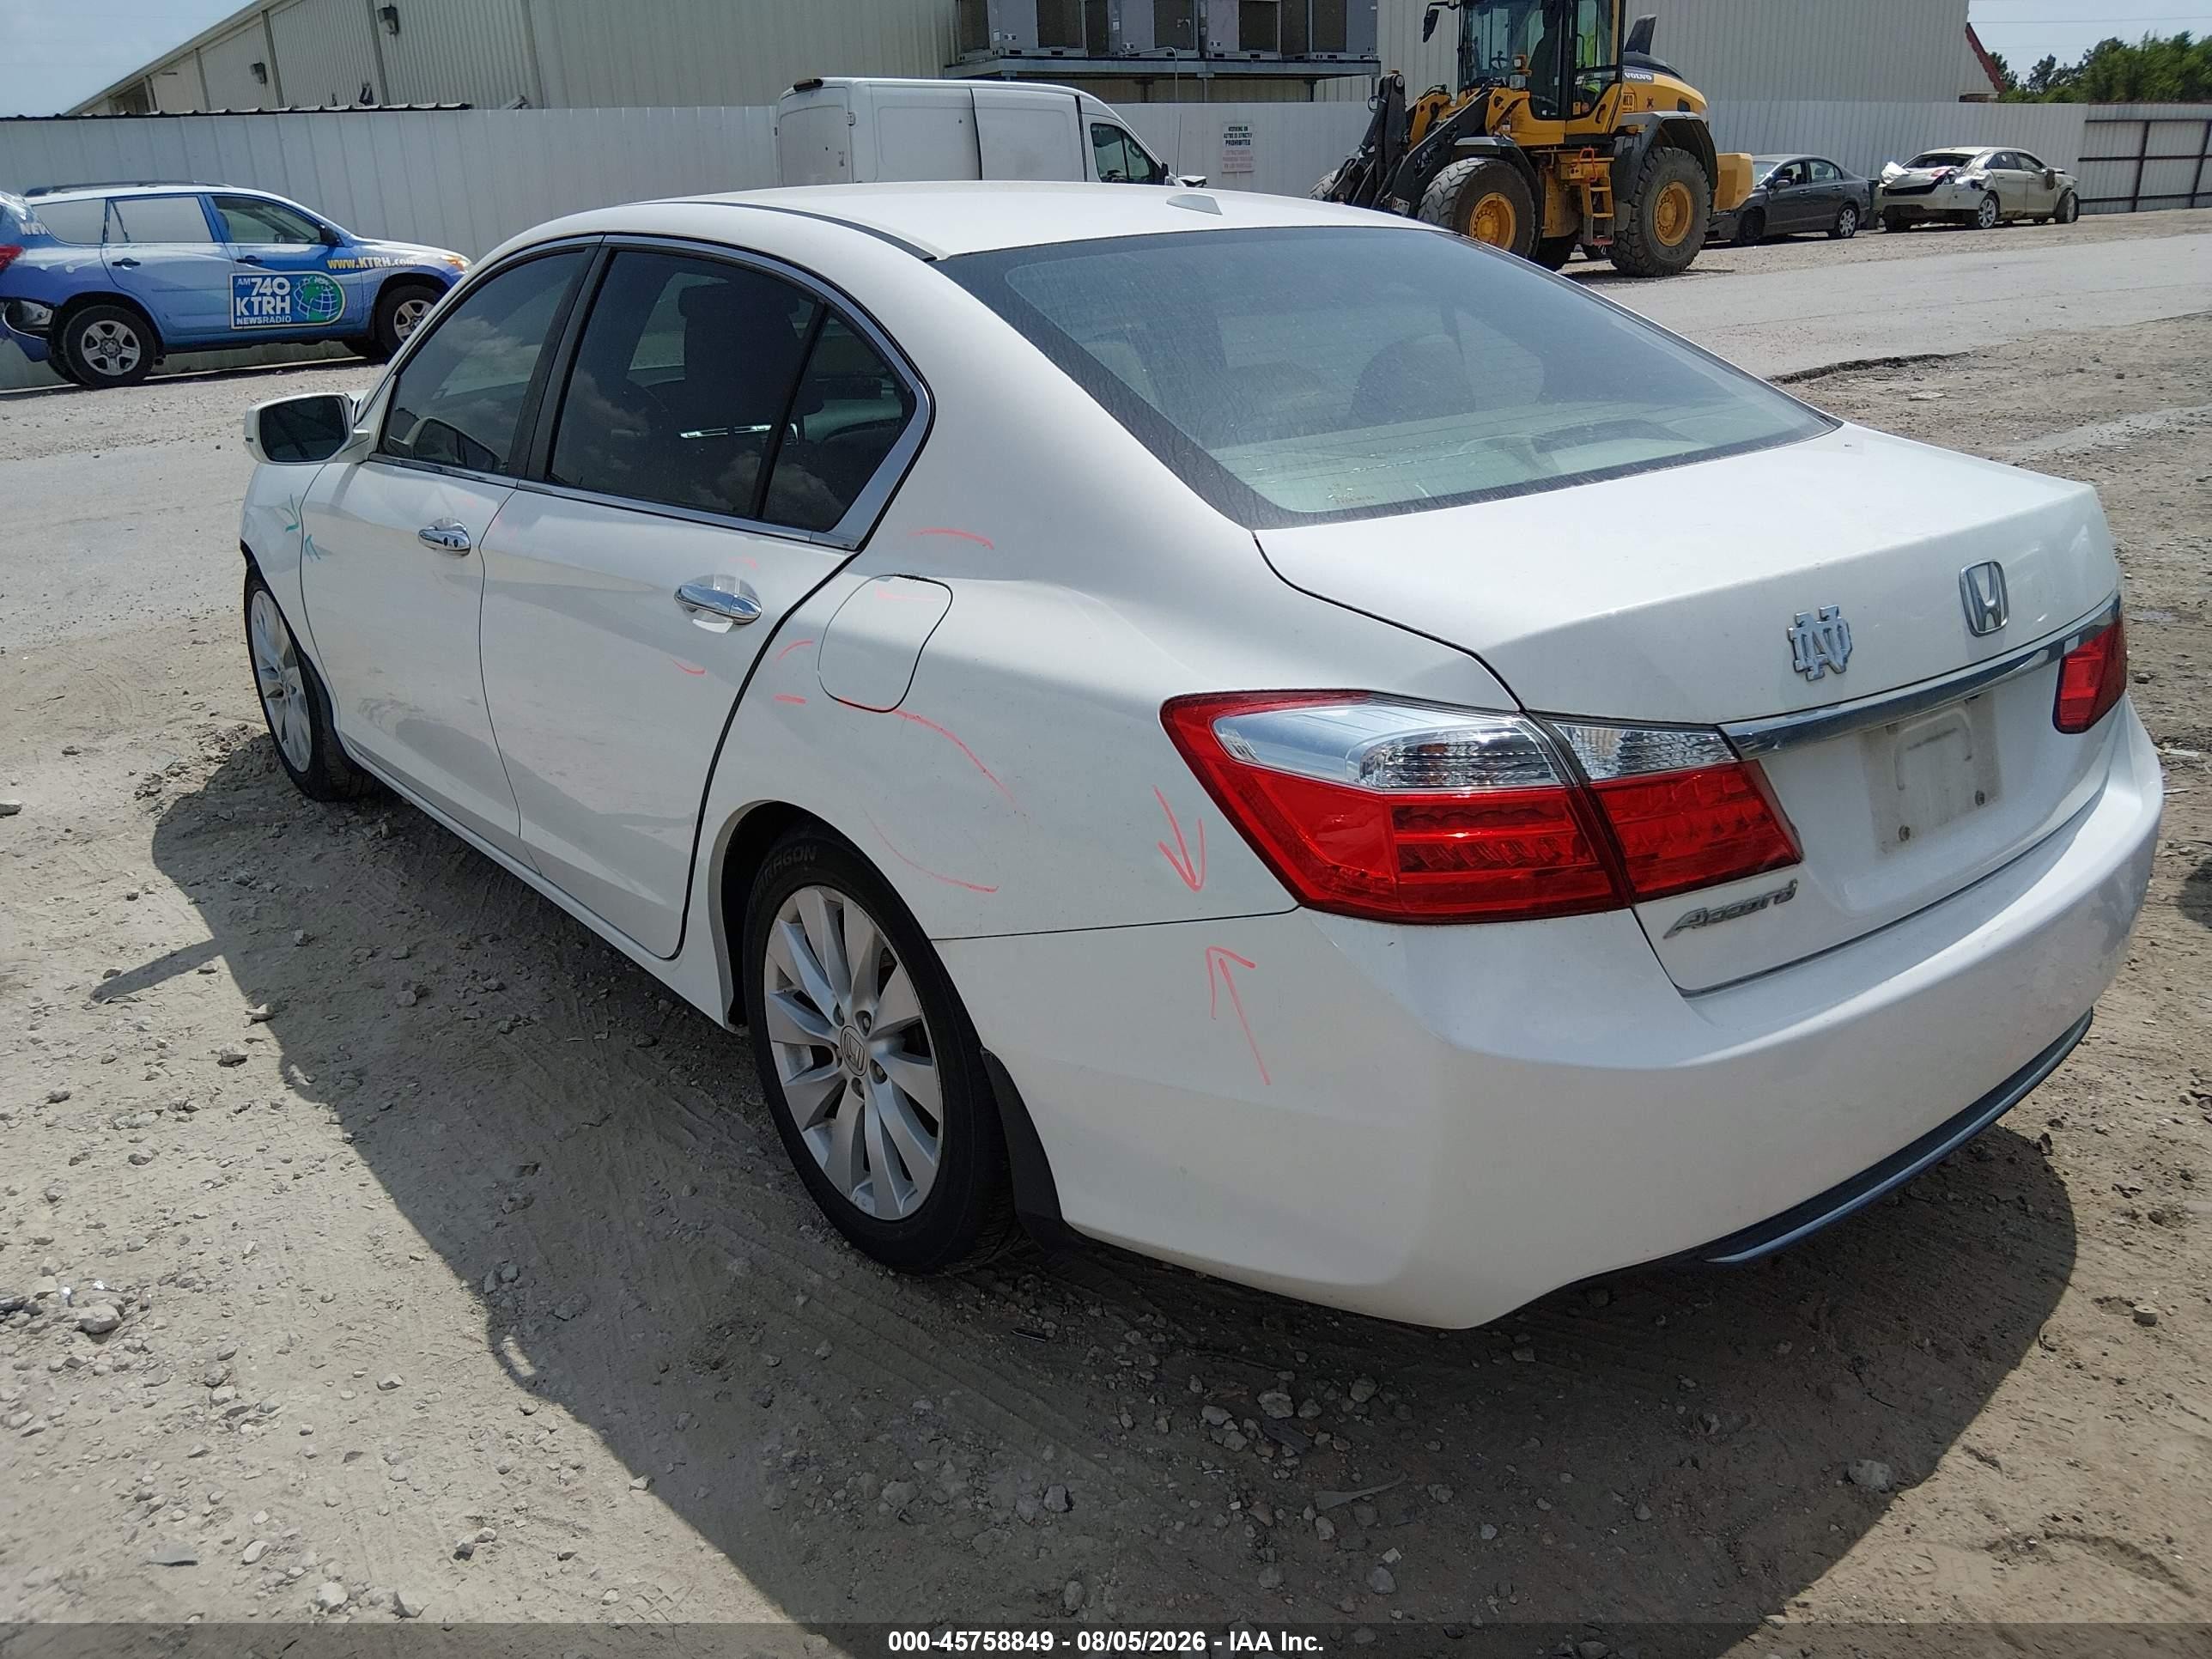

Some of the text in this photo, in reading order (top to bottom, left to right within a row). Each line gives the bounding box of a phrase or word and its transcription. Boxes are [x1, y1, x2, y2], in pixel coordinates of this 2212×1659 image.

[1624, 72, 1652, 81] VOLVO
[236, 276, 290, 296] AM 740
[235, 295, 291, 317] KTRH
[236, 315, 292, 325] NEWSRADIO
[1662, 878, 1798, 939] Accord
